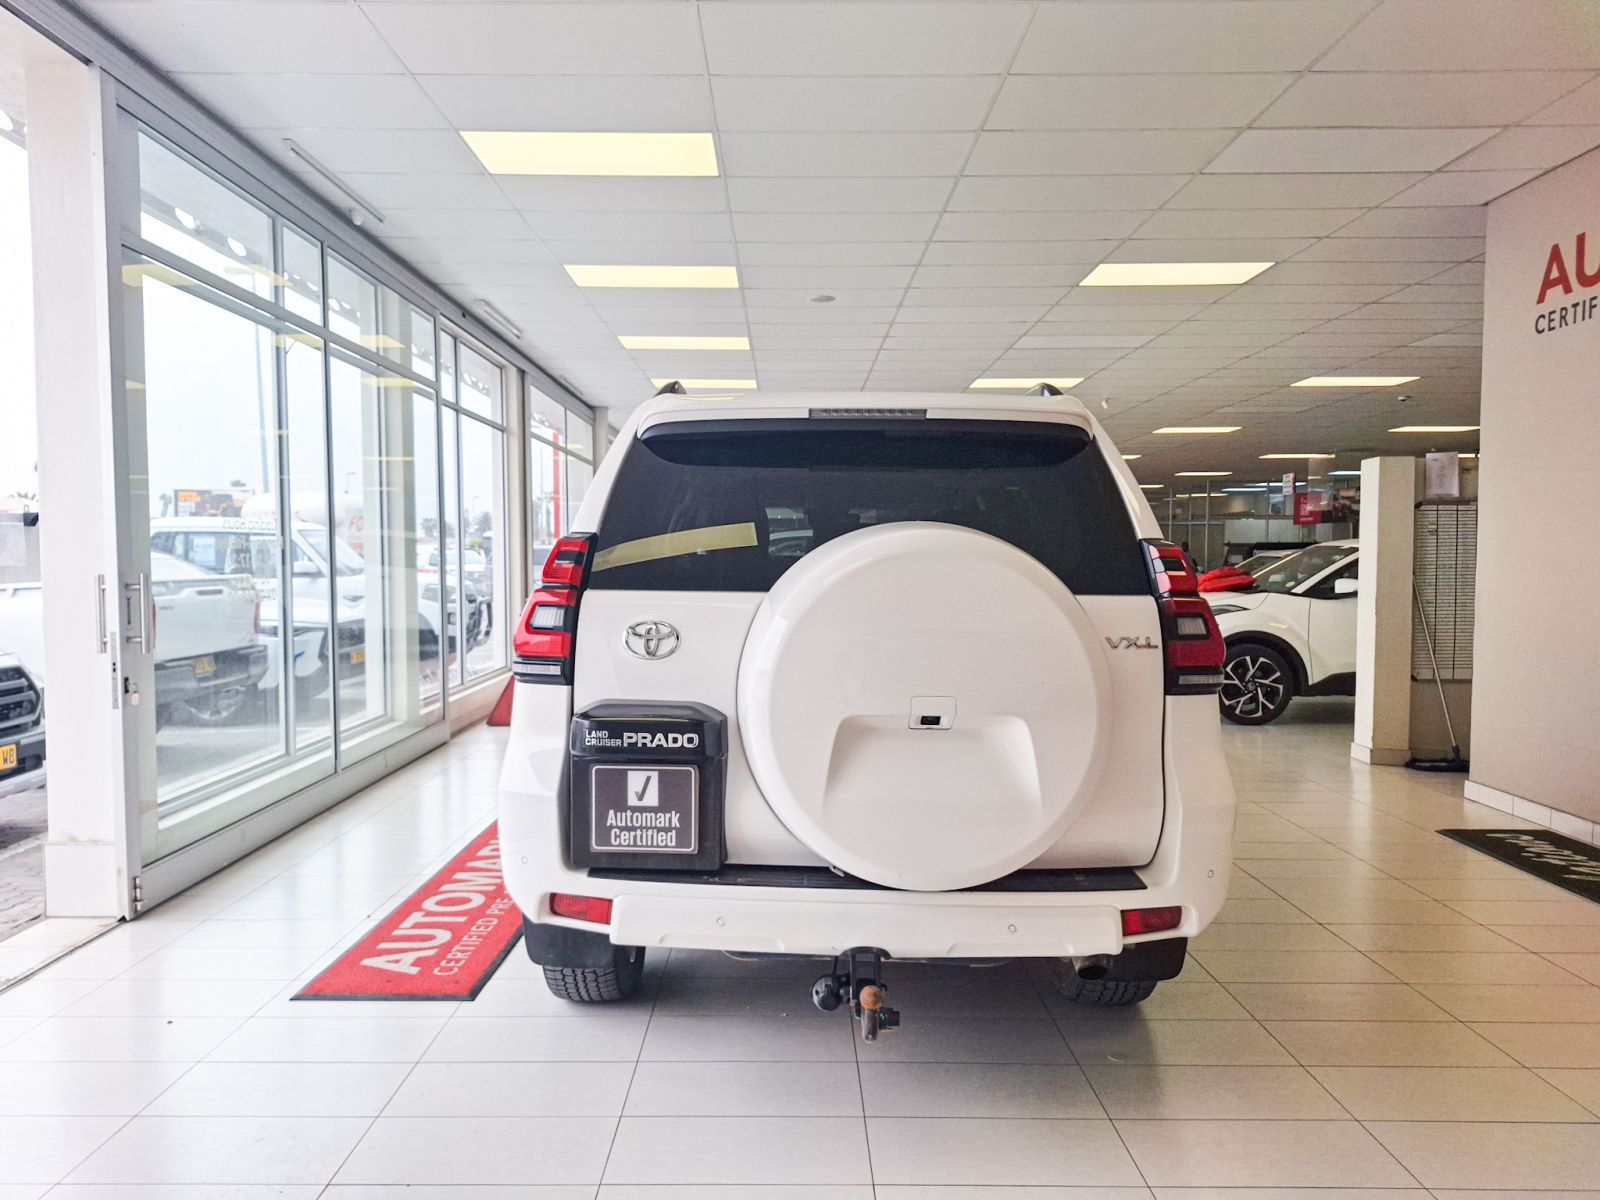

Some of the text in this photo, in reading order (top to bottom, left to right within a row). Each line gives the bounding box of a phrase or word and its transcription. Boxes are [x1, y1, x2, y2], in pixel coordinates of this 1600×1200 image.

[585, 729, 609, 738] LAND
[585, 737, 622, 747] CRUISER
[623, 732, 699, 748] PRADO
[606, 809, 681, 828] Automark
[610, 828, 676, 847] Certified
[359, 838, 503, 976] AUTOMAR
[433, 916, 499, 976] CERTIFIED
